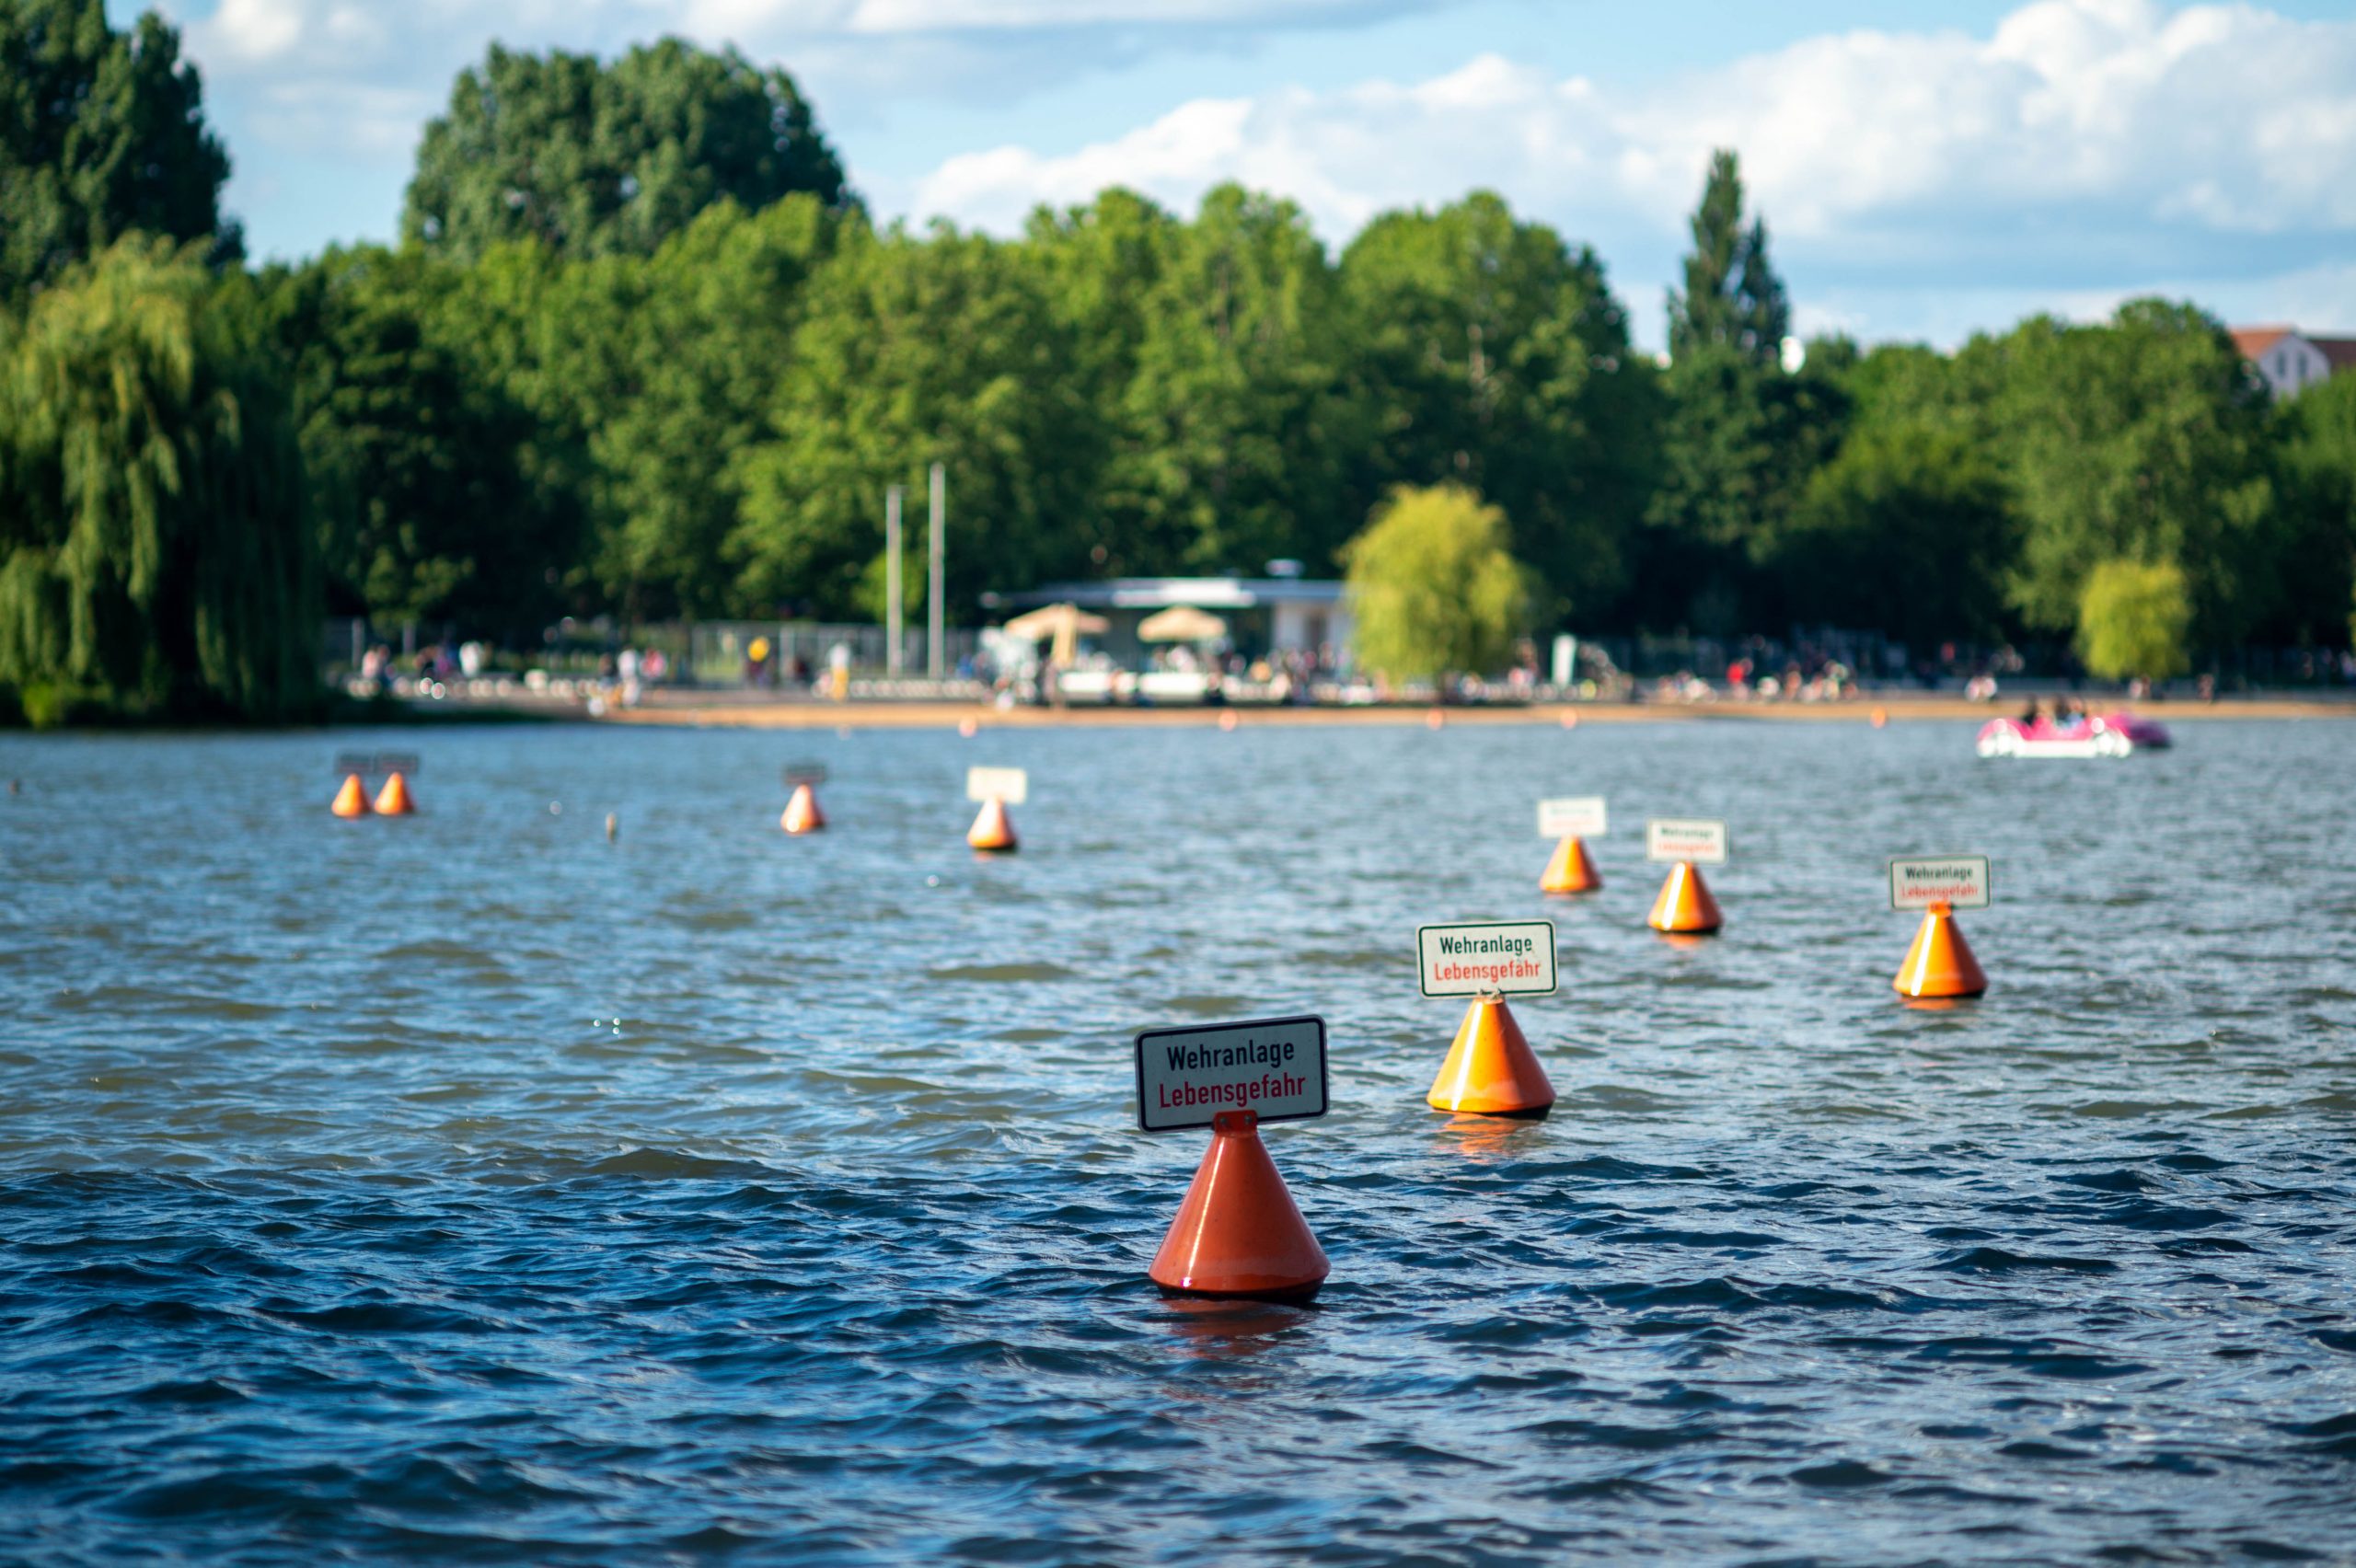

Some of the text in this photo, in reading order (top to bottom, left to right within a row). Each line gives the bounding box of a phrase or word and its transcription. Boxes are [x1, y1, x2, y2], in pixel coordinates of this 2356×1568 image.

[1439, 935, 1532, 956] Wehranlage
[1434, 959, 1541, 983] Lebensgefahr
[1167, 1040, 1295, 1071] Wehranlage
[1159, 1072, 1306, 1108] Lebensgefahr
